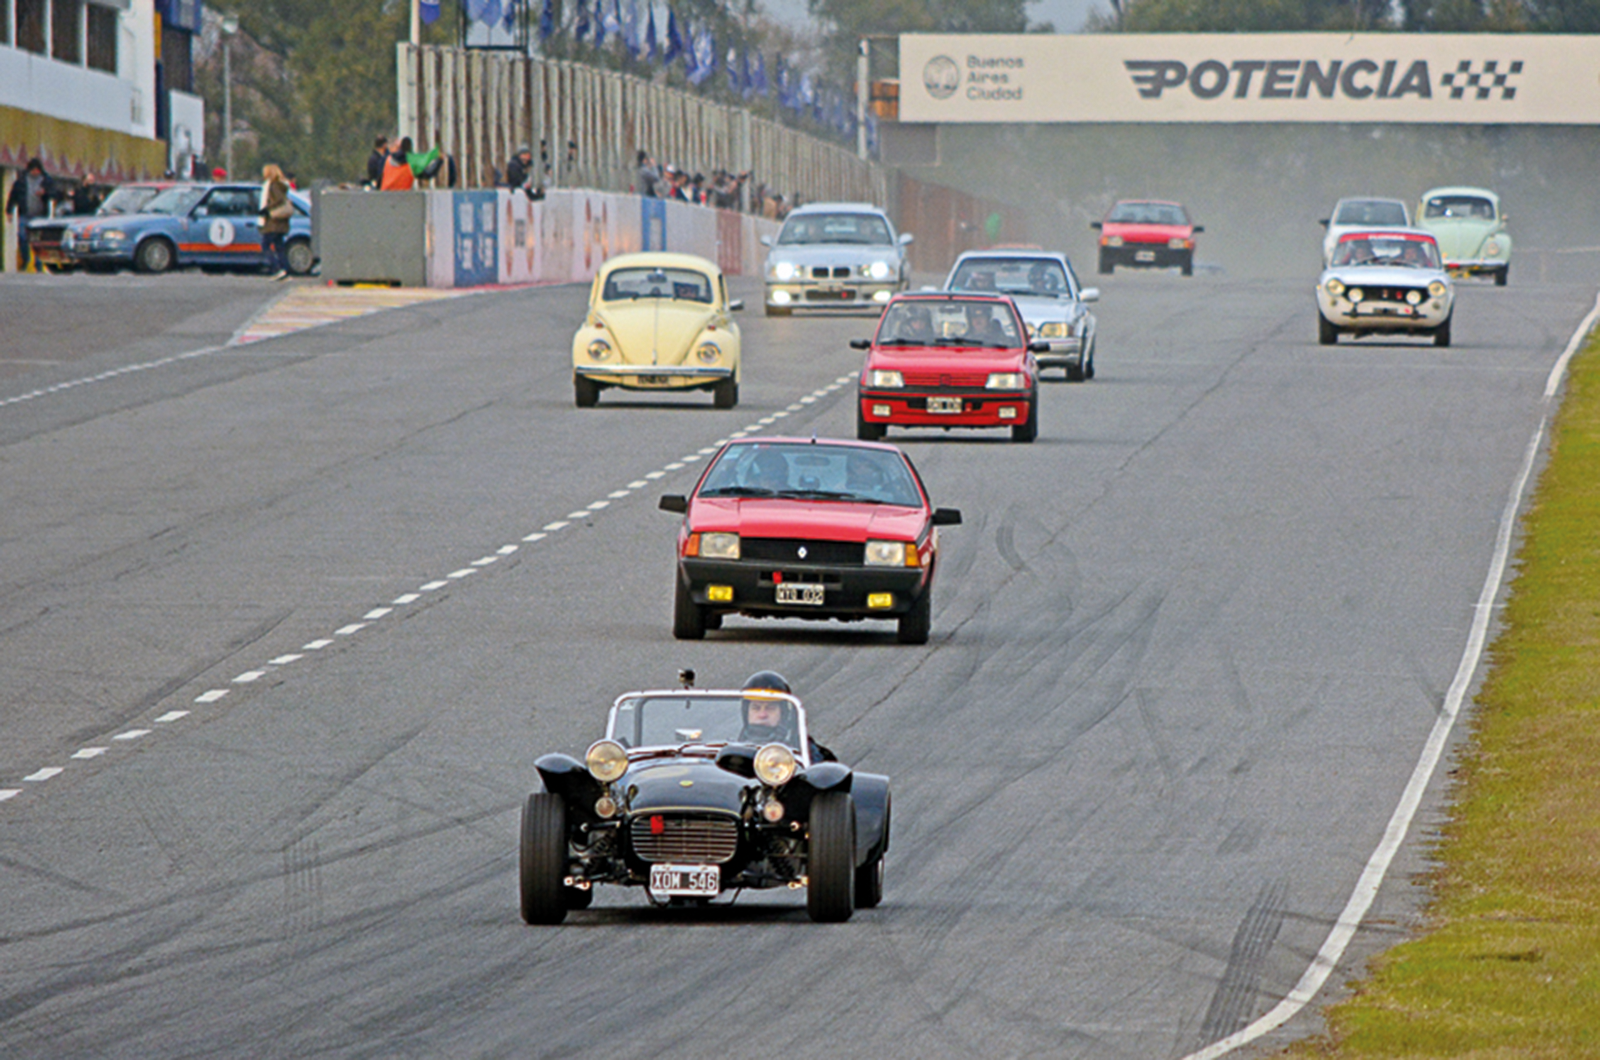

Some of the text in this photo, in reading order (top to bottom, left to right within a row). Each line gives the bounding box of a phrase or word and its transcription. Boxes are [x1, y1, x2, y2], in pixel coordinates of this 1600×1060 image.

[967, 55, 1024, 68] Buenos
[967, 71, 1009, 84] Aires
[1123, 59, 1433, 100] POTENCIA
[966, 86, 1023, 100] Ciudad
[653, 872, 716, 890] XOM 546
